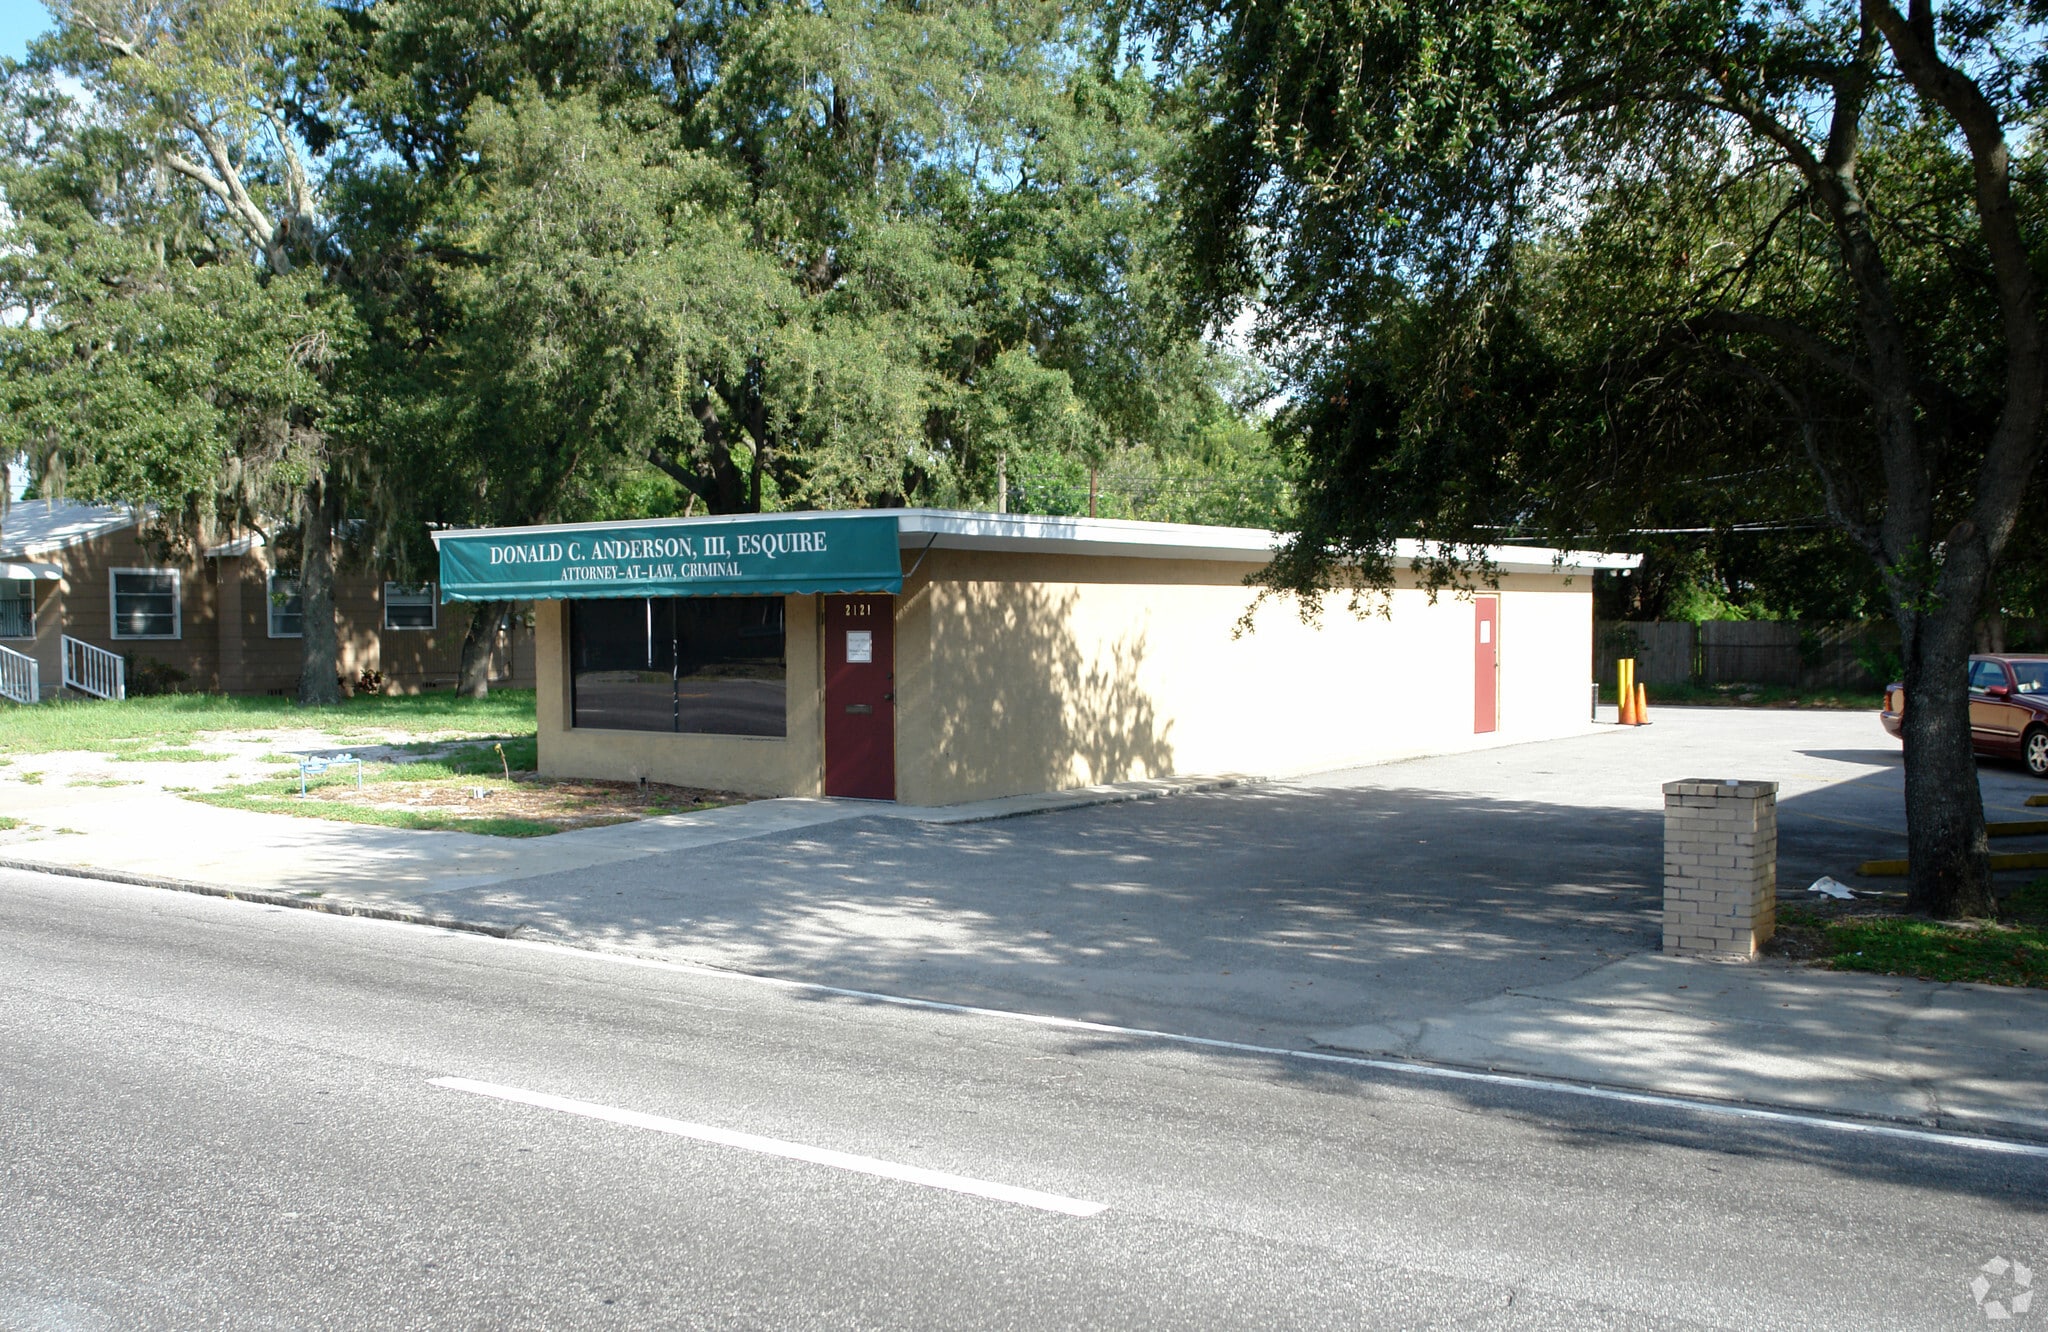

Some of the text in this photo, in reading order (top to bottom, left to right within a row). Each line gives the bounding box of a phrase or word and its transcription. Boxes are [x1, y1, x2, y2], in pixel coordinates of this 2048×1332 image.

[490, 531, 827, 565] DONALD C. ANDERSON, III, ESQUIRE
[560, 562, 742, 581] ATTORNEY-AT-LAW, CRIMINAL
[845, 604, 871, 617] 2121
